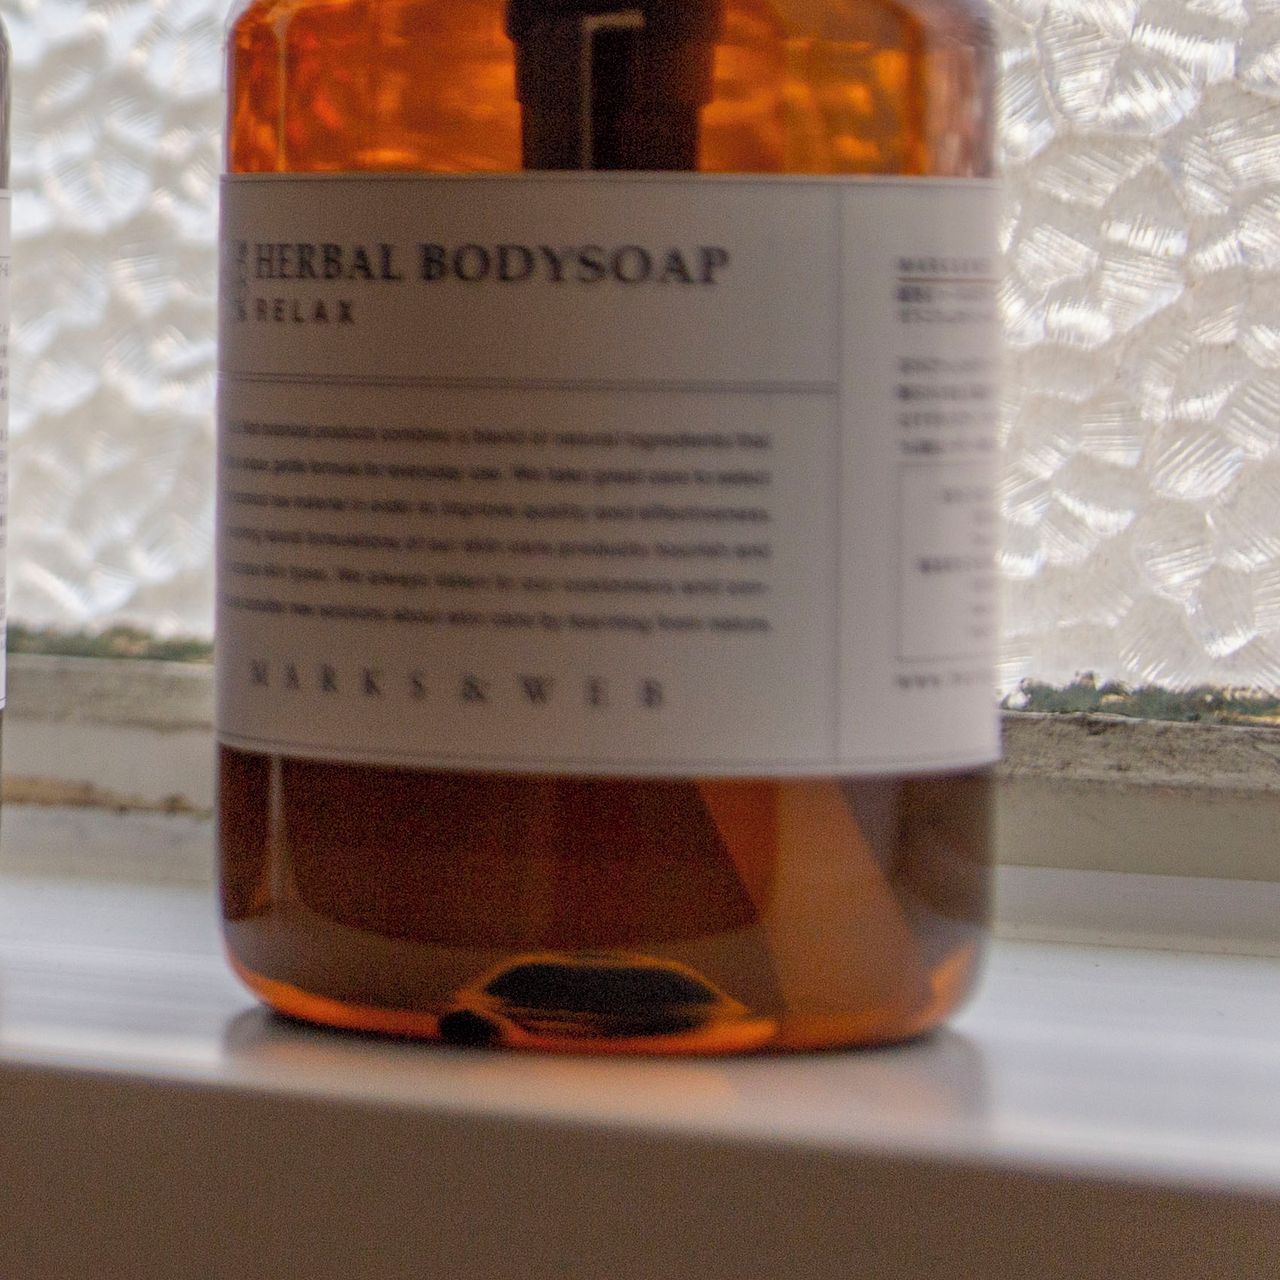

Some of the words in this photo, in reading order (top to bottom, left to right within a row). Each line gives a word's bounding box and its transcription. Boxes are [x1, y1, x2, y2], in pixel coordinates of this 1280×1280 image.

[254, 242, 405, 281] HERBAL
[417, 242, 731, 285] BODYSOAP
[254, 297, 356, 325] RELAX
[248, 657, 429, 703] MARKS
[457, 671, 493, 705] &
[515, 672, 666, 710] WEB
